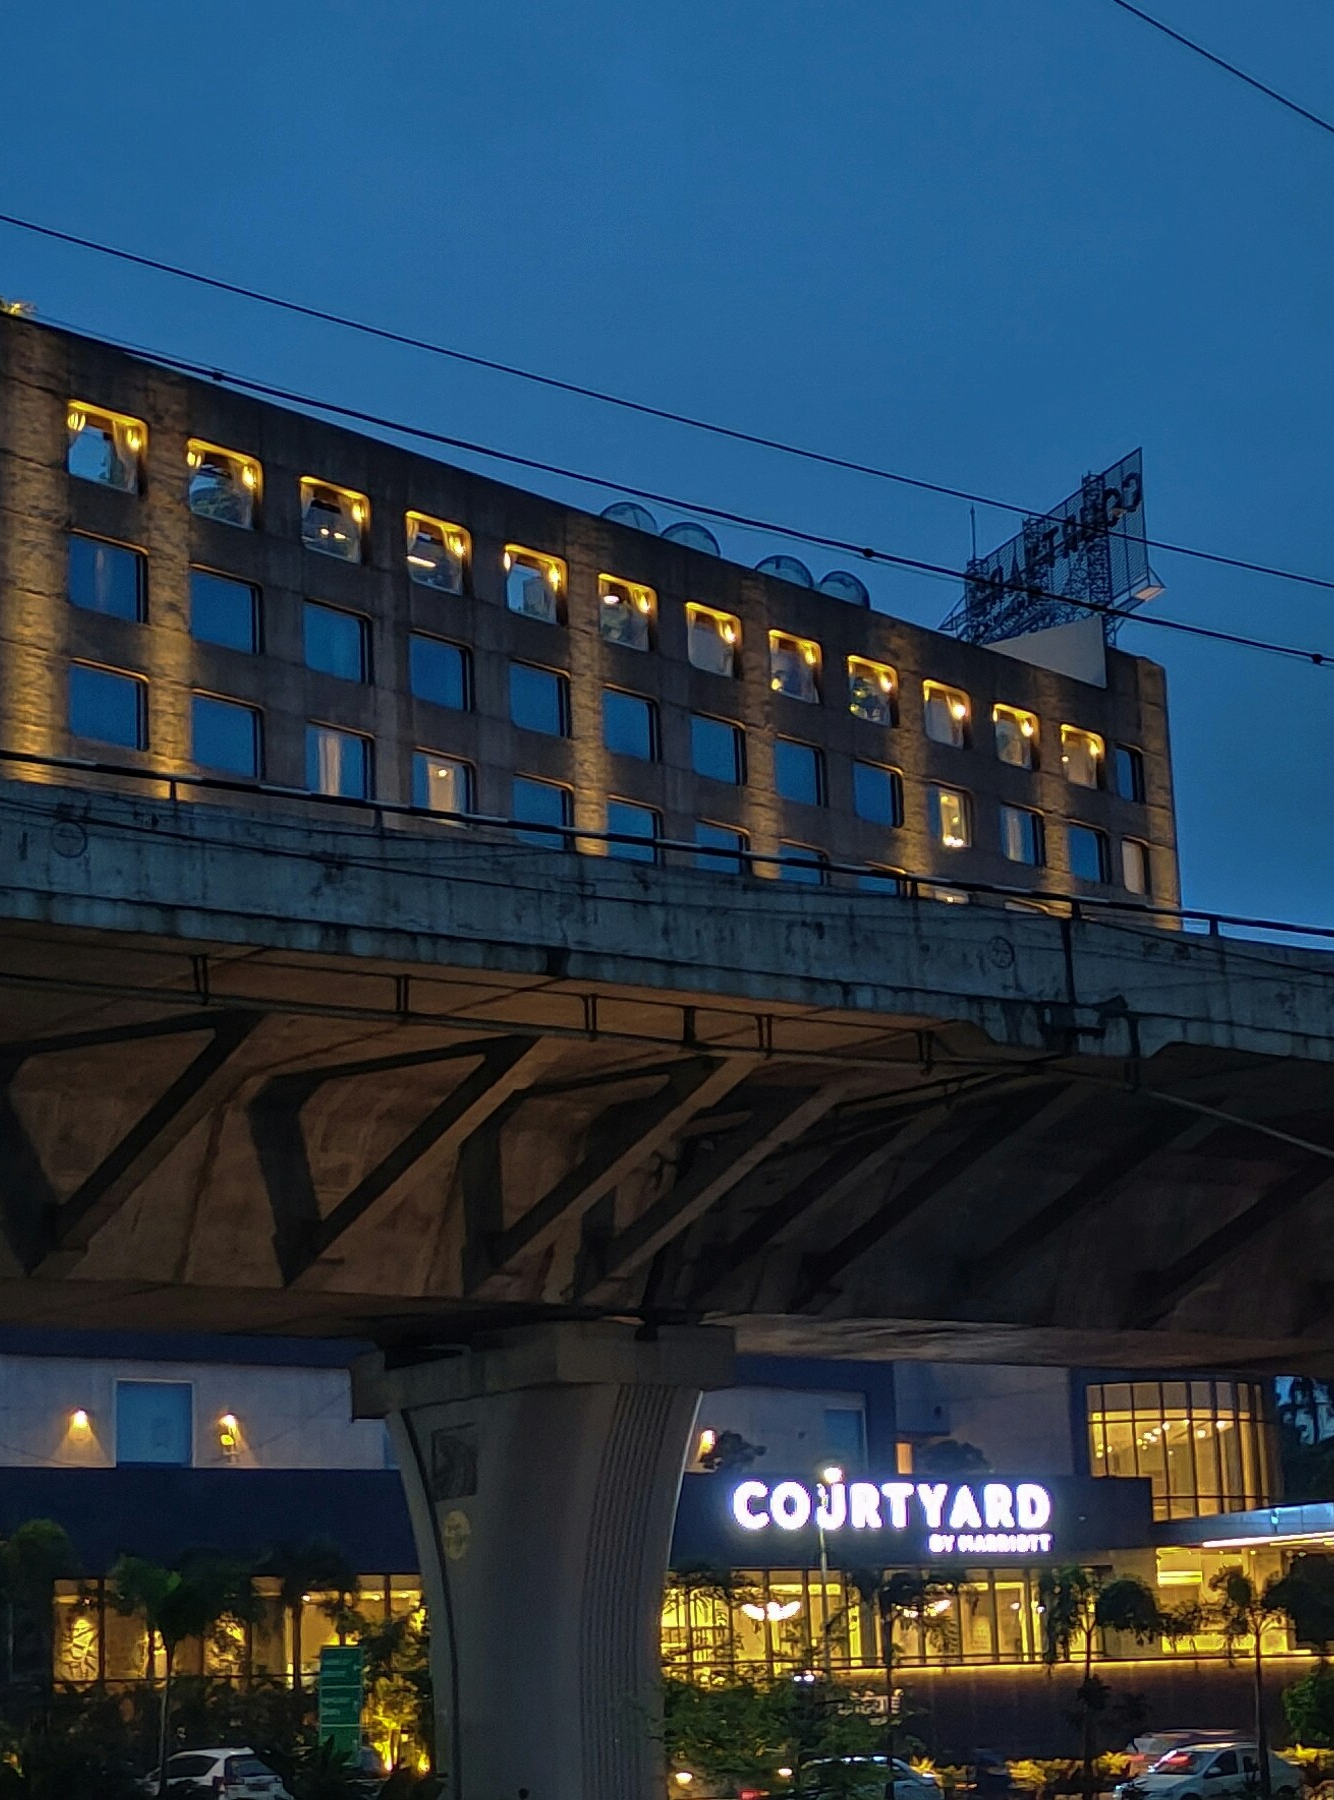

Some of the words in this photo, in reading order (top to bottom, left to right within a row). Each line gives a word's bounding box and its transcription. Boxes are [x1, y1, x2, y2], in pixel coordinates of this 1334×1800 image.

[733, 1480, 1051, 1530] COURTYARD
[929, 1533, 955, 1553] BY
[957, 1533, 1051, 1553] MARRIOTT
